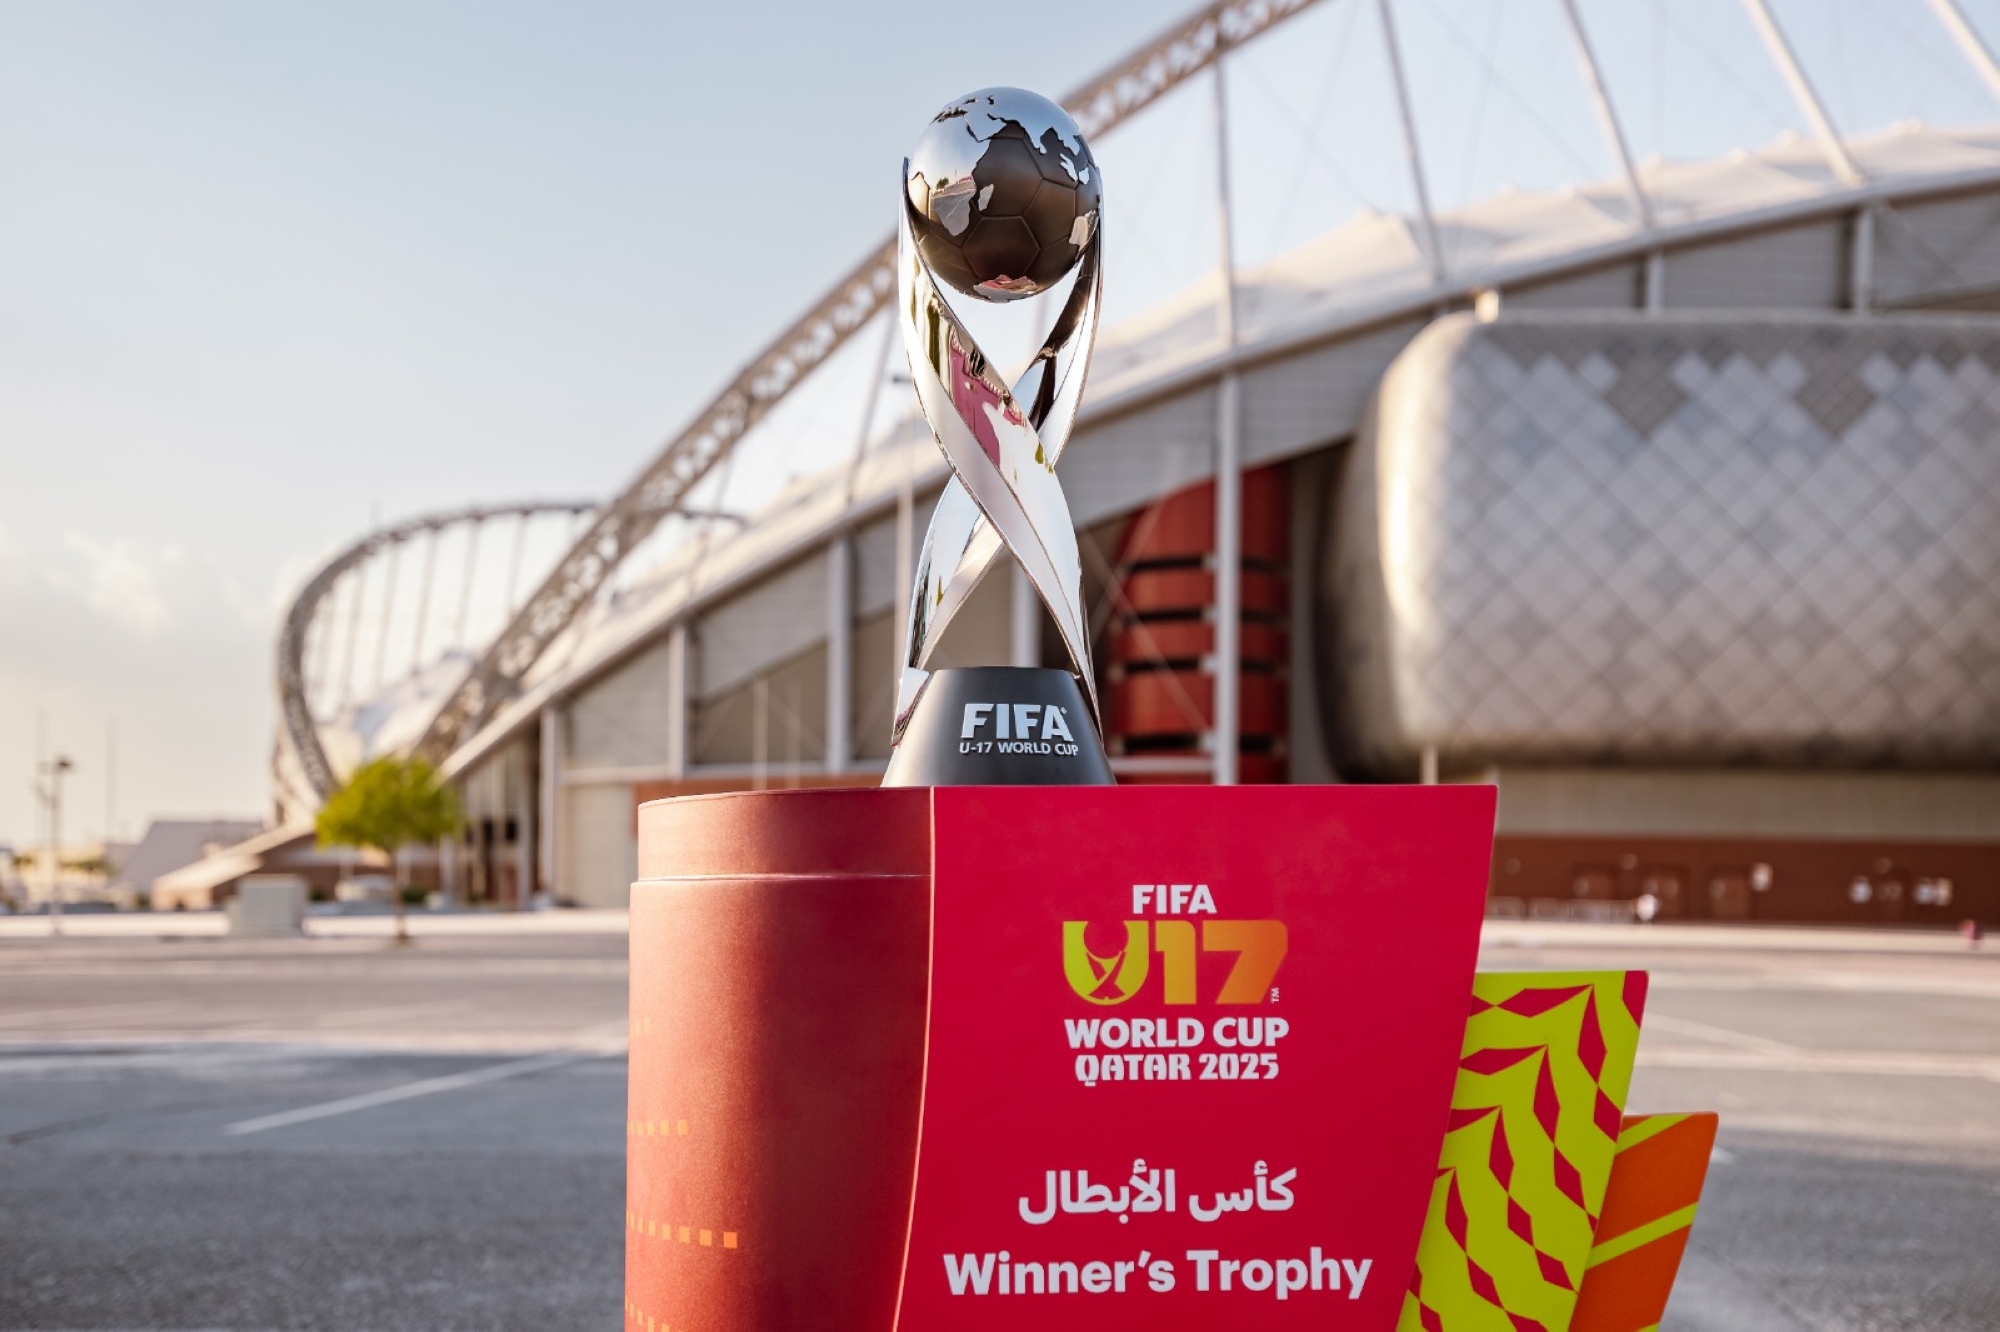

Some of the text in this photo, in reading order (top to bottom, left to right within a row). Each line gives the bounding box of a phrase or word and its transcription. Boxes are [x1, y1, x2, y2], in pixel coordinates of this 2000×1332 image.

[961, 703, 1075, 742] FIFA
[959, 741, 1079, 756] U-17 WORLD CUP
[1132, 884, 1218, 915] FIFA
[1062, 919, 1289, 1006] U17
[1064, 1016, 1290, 1049] WORLD CUP
[1074, 1052, 1280, 1087] QATAR 2025
[1018, 1158, 1298, 1225] كأس الأبطال
[942, 1246, 1374, 1301] Winner's Trophy
